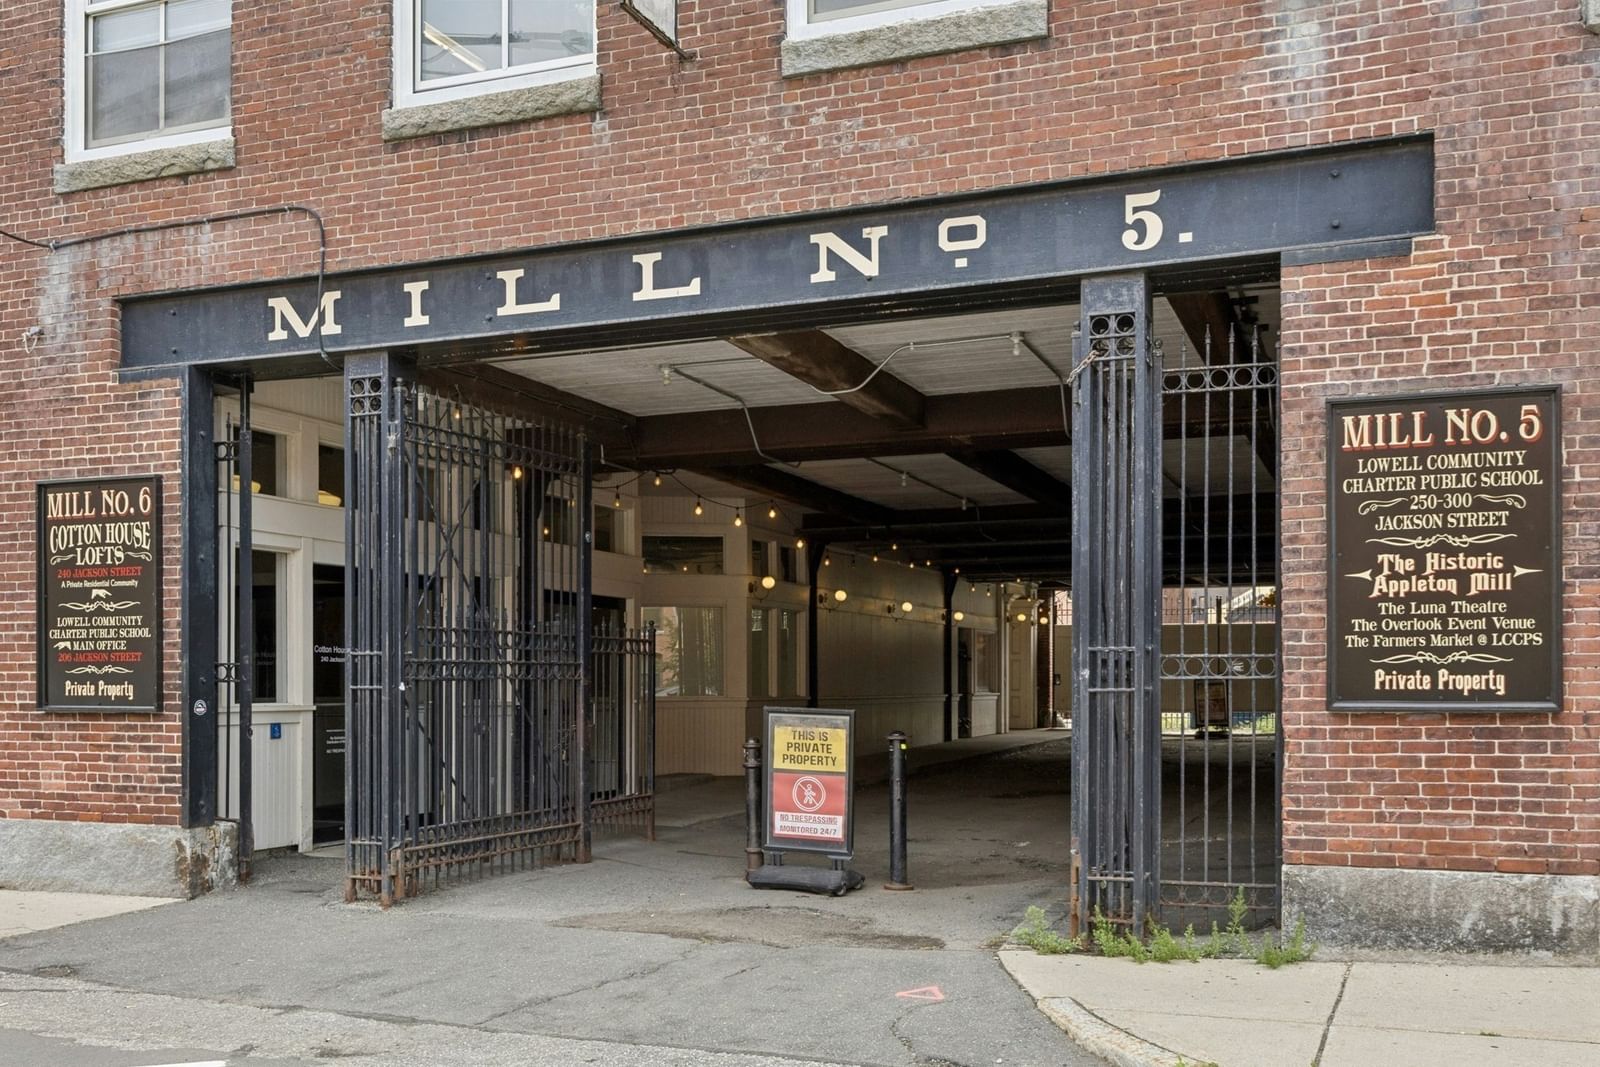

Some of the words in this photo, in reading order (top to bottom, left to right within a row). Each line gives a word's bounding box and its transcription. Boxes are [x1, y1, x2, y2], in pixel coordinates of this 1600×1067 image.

[267, 252, 701, 341] MILL
[1341, 410, 1434, 451] MILL
[1444, 407, 1509, 445] NO.
[1518, 404, 1544, 442] 5
[1357, 455, 1422, 474] LOWELL
[1427, 450, 1527, 470] COMMUNITY
[1342, 475, 1416, 494] CHARTER
[1420, 472, 1477, 490] PUBLIC
[1480, 469, 1543, 487] SCHOOL
[47, 491, 96, 519] MILL
[101, 489, 135, 516] NO.
[139, 486, 152, 515] 6
[1409, 493, 1472, 510] 250-300
[1375, 513, 1443, 531] JACKSON
[1447, 511, 1509, 529] STREET
[50, 523, 102, 553] COTTON
[105, 521, 150, 550] HOUSE
[75, 545, 125, 566] LOFTS
[1377, 553, 1415, 576] The
[1424, 552, 1504, 575] Historic
[57, 569, 71, 578] 240
[73, 568, 109, 577] JACKSON
[110, 566, 143, 576] STREET
[66, 580, 83, 588] Private
[110, 579, 138, 588] Community
[1368, 575, 1457, 598] Appleton
[1466, 573, 1513, 596] Mill
[1378, 602, 1405, 615] The
[1410, 602, 1446, 615] Luna
[1451, 601, 1507, 614] Theatre
[57, 617, 90, 627] LOWELL
[92, 615, 143, 626] COMMUNITY
[1351, 619, 1377, 632] The
[1381, 617, 1442, 631] Overlook
[1447, 617, 1486, 630] Event
[1493, 617, 1535, 629] Venue
[49, 629, 87, 639] CHARTER
[89, 628, 118, 638] PUBLIC
[119, 628, 151, 638] SCHOOL
[1345, 635, 1369, 647] The
[1373, 634, 1426, 647] Farmers
[1430, 634, 1473, 647] Market
[1492, 632, 1543, 646] LCCPS
[73, 641, 95, 650] MAIN
[96, 640, 127, 650] OFFICE
[73, 652, 109, 662] JACKSON
[110, 652, 143, 662] STREET
[1374, 669, 1431, 691] Private
[1437, 668, 1506, 696] Property
[65, 680, 95, 696] Private
[98, 680, 134, 700] Property
[791, 730, 816, 741] THIS
[818, 731, 829, 741] IS
[786, 742, 832, 754] PRIVATE
[782, 754, 837, 767] PROPERTY
[779, 813, 790, 823] NO
[792, 814, 838, 825] TRESPASSING
[779, 824, 818, 835] MONITORED
[819, 826, 837, 836] 24/7
